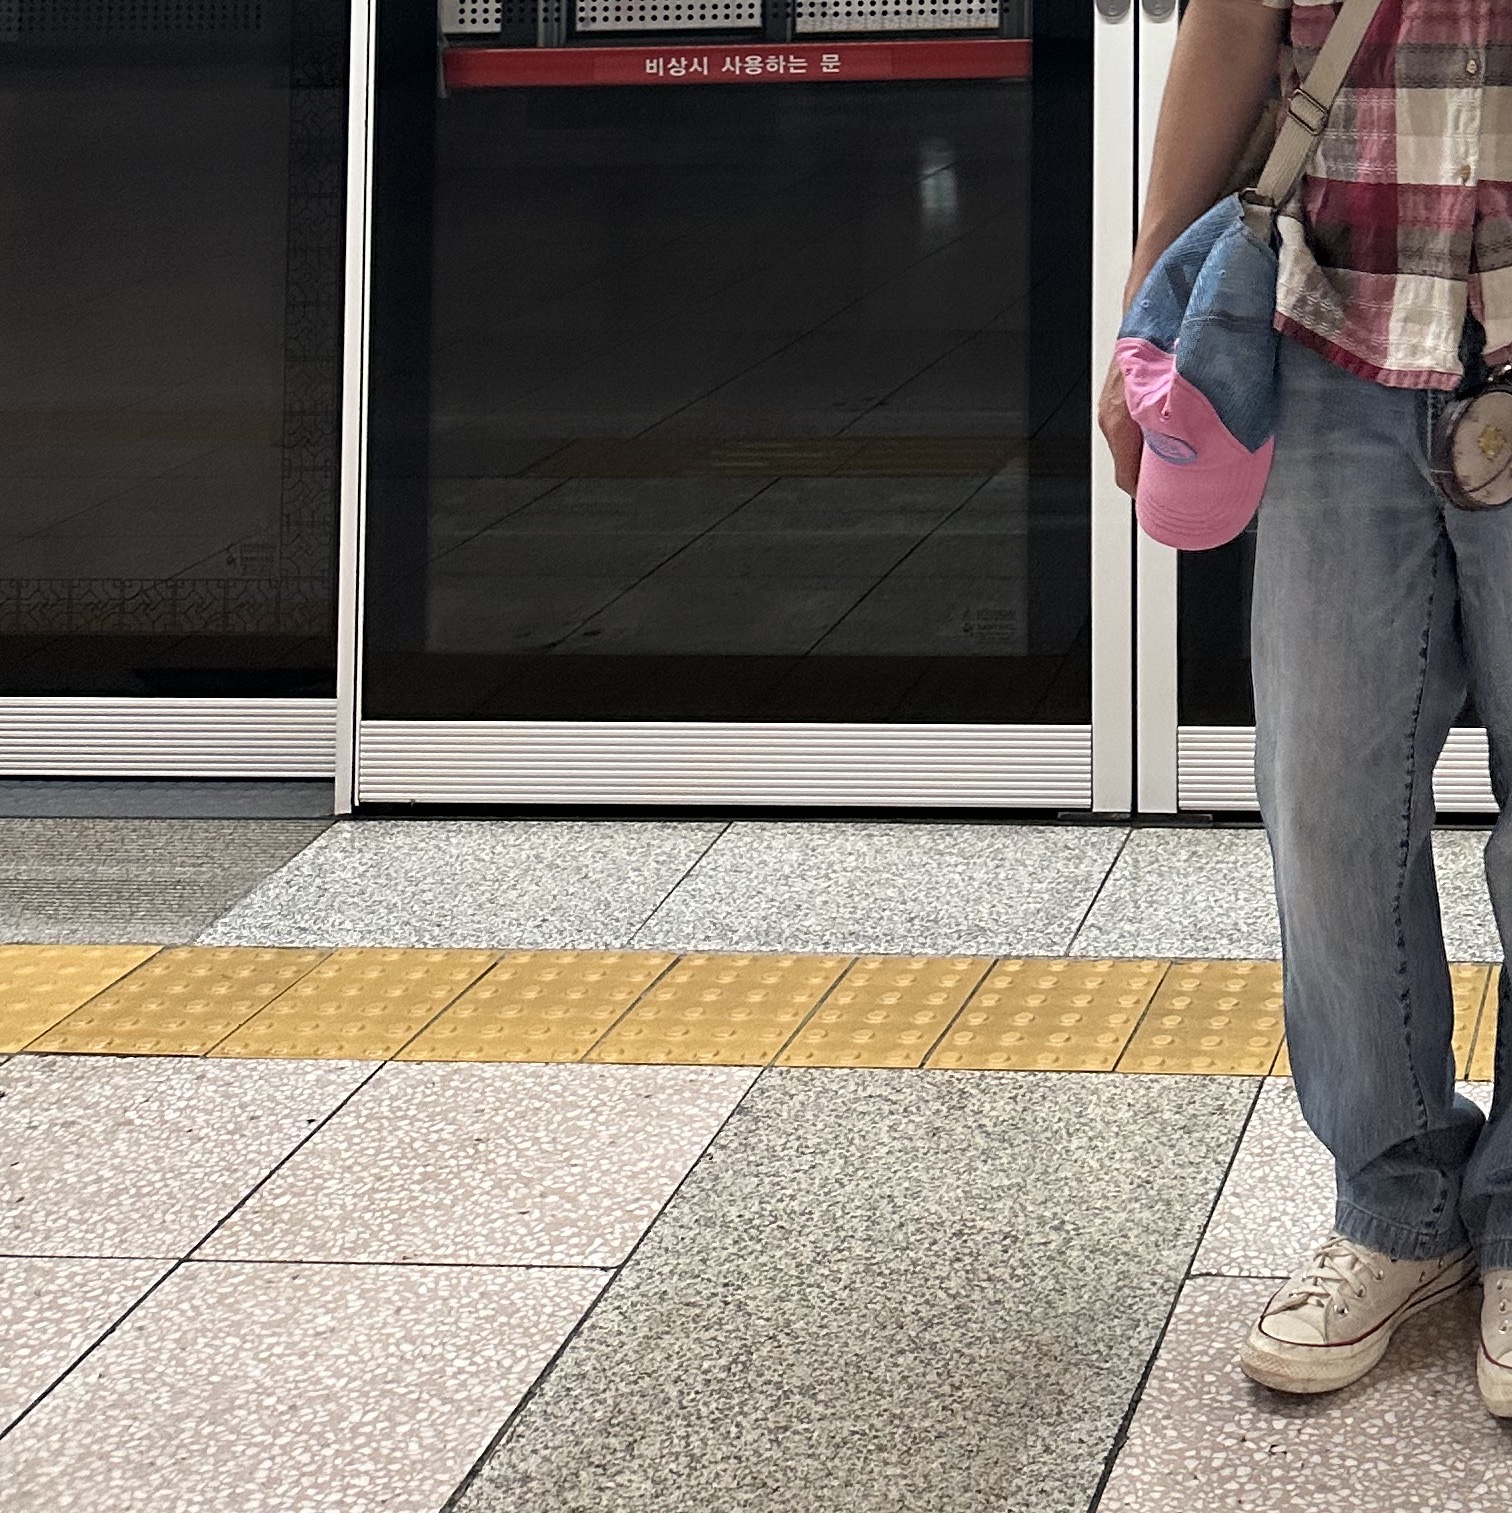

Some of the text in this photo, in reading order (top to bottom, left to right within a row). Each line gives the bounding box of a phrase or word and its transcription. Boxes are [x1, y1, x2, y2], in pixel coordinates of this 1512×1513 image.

[645, 54, 841, 76] 비상시 사용하는 문
